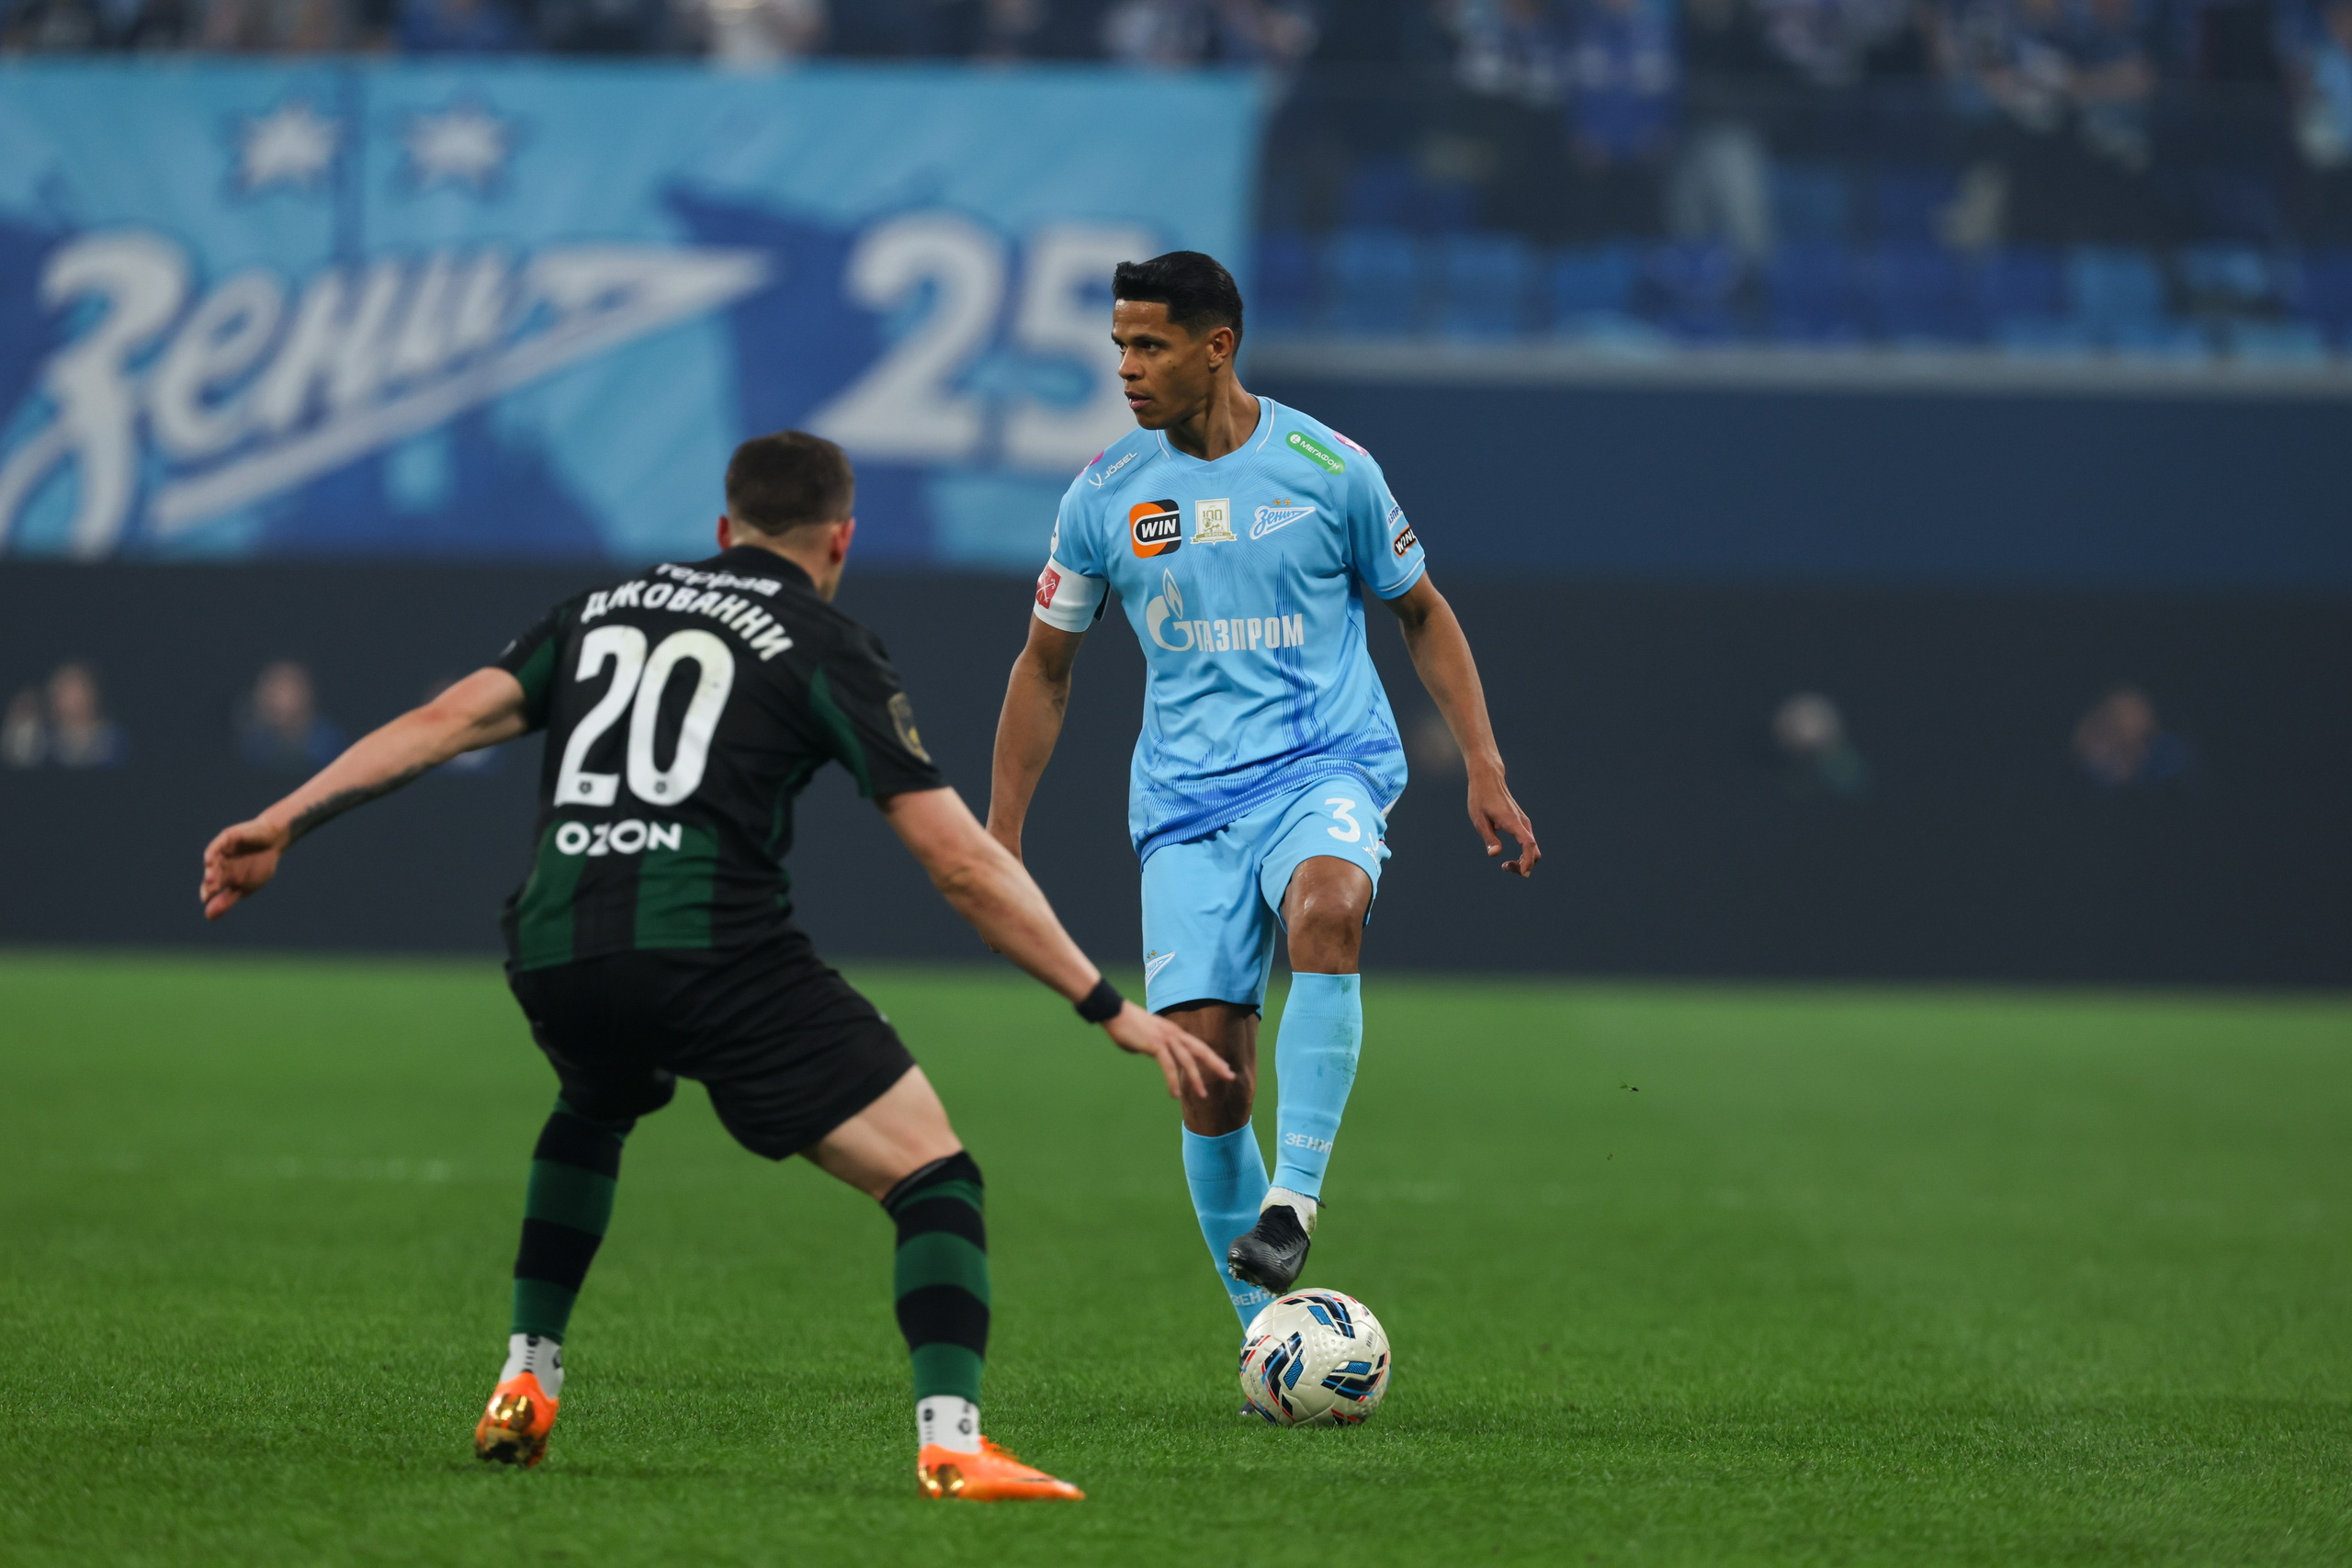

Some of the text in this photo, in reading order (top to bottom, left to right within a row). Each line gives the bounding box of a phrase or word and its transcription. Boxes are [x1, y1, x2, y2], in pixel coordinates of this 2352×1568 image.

[808, 216, 1158, 468] 25
[1104, 451, 1138, 479] JÖGEL
[1300, 440, 1340, 470] МЕГАФОН
[1141, 518, 1177, 538] WIN
[580, 580, 794, 661] ДЖОВАННИ
[1193, 613, 1305, 653] ГАЗПРОМ
[553, 624, 735, 807] 20
[555, 818, 683, 856] OZON
[1324, 797, 1362, 843] 3
